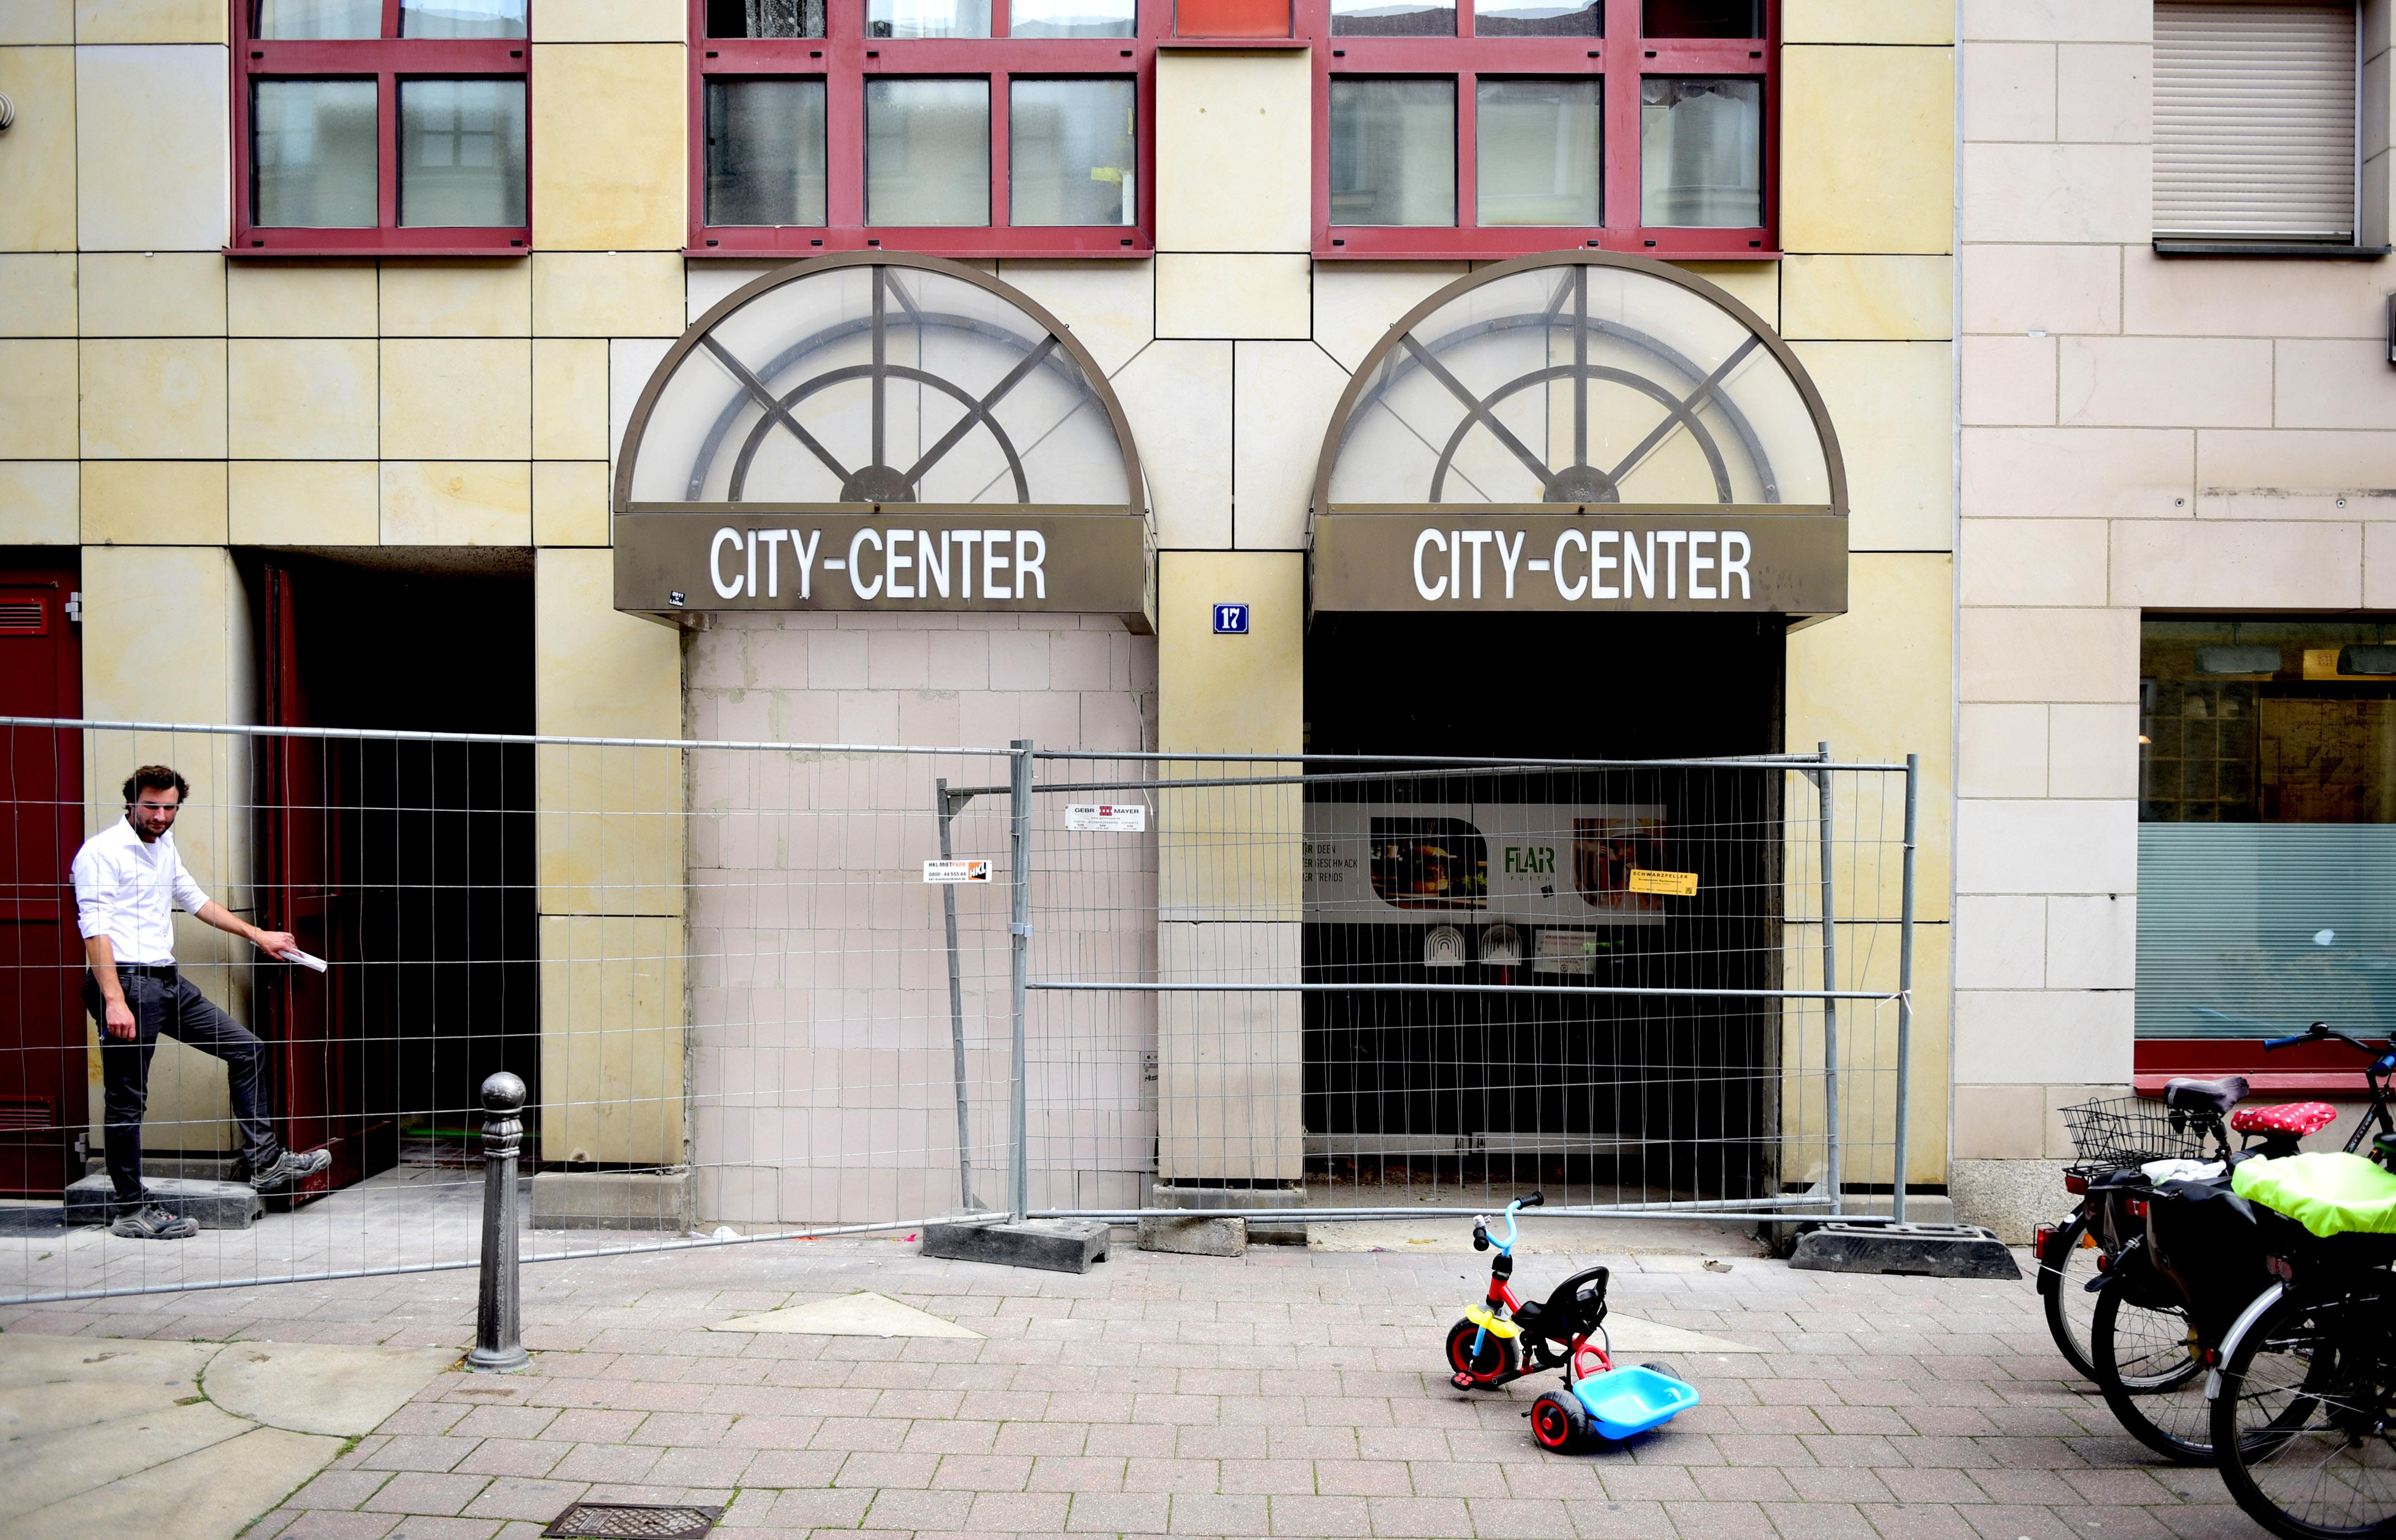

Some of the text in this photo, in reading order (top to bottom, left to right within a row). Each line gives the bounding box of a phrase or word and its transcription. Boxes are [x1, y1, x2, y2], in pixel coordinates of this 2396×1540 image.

[710, 526, 1046, 599] CITY-CENTER
[1413, 527, 1751, 600] CITY-CENTER
[1222, 608, 1240, 628] 17
[1315, 845, 1336, 854] DEEN
[970, 862, 986, 878] HKL
[1315, 858, 1358, 868] GESCHMACK
